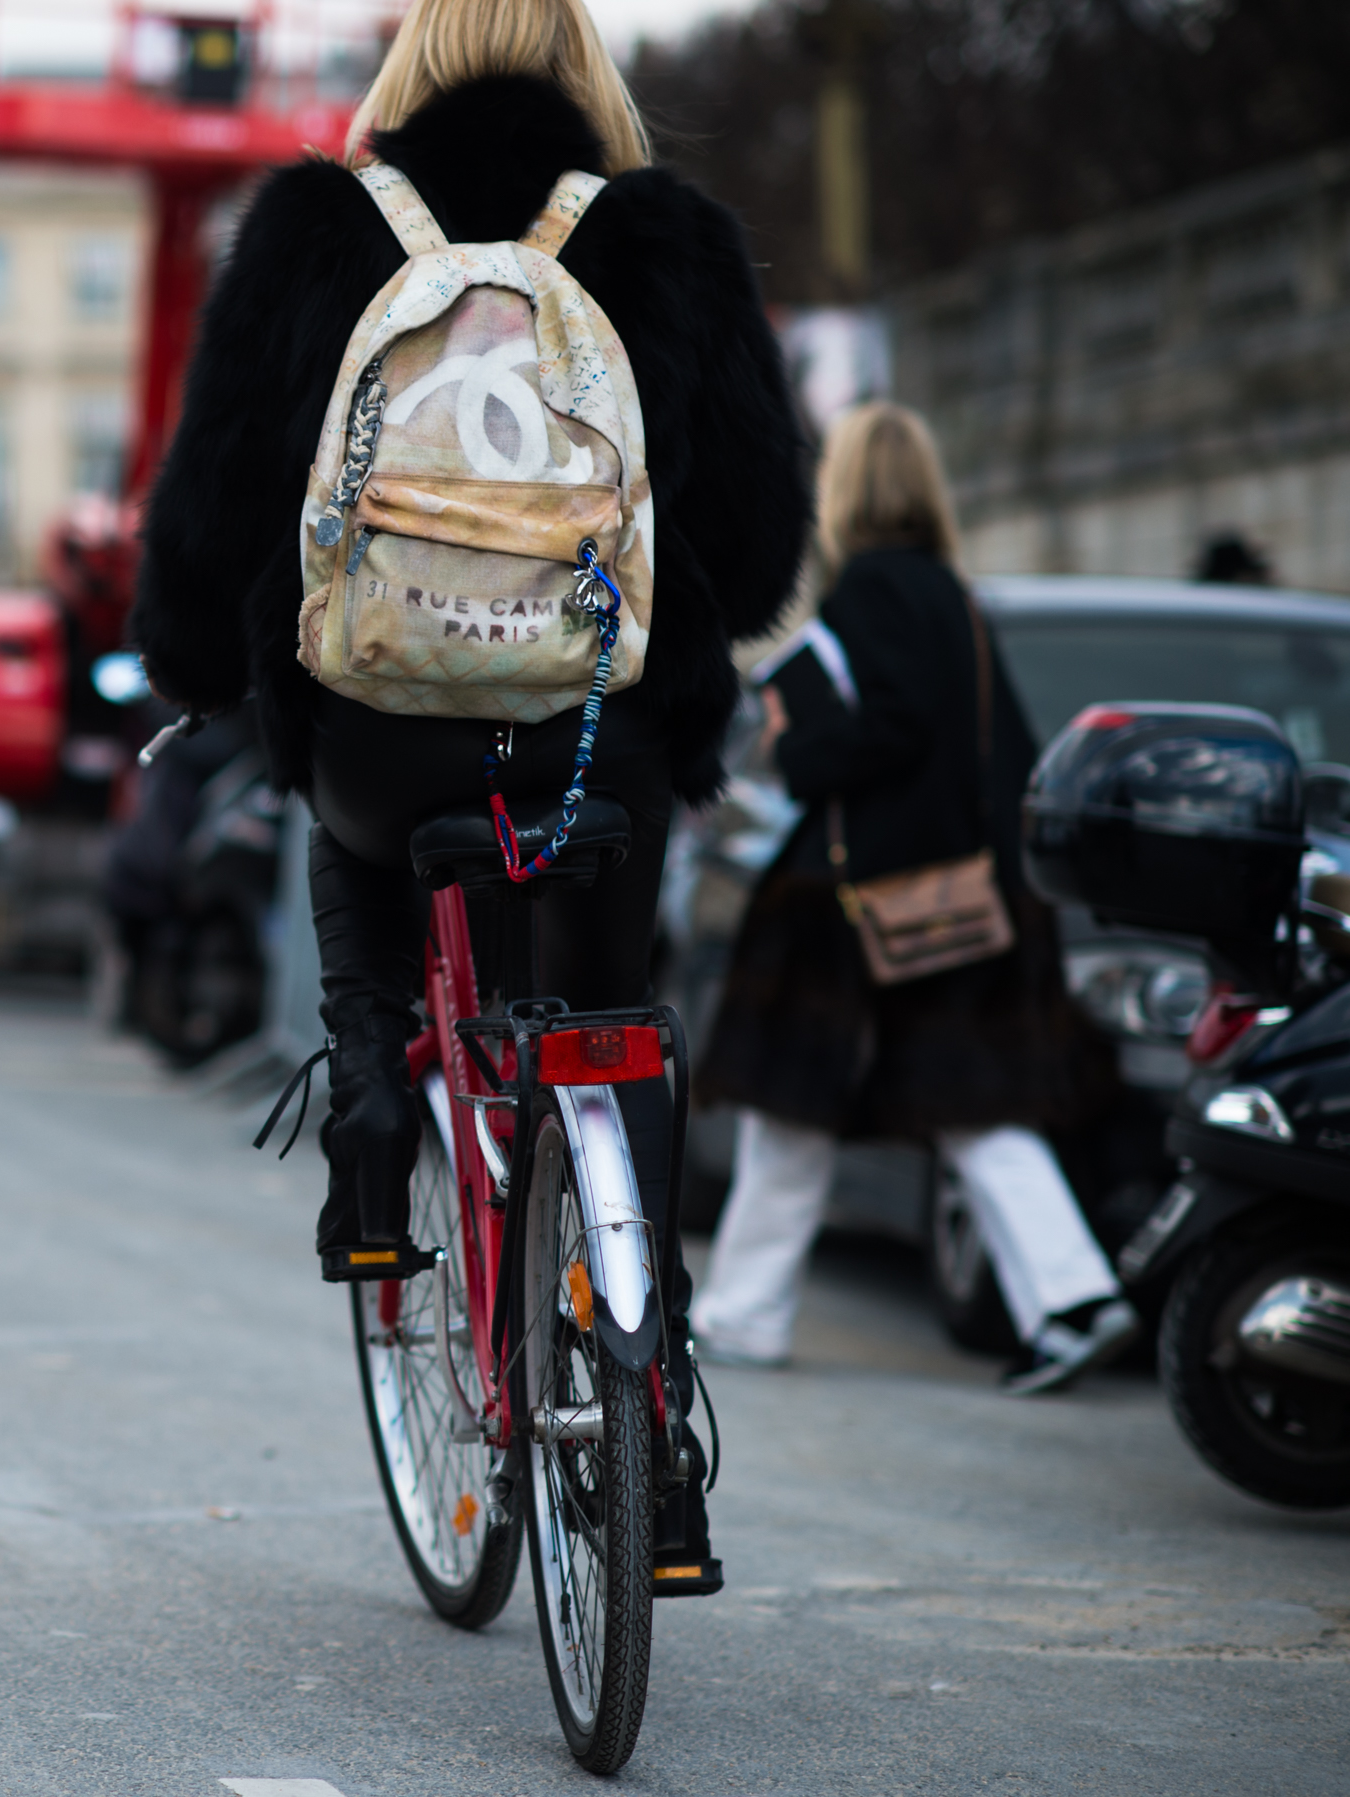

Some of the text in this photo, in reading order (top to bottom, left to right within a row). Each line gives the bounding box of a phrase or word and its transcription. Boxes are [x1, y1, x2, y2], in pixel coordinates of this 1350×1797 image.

[366, 580, 389, 600] 31
[405, 586, 470, 613] RUE
[443, 620, 540, 643] PARIS
